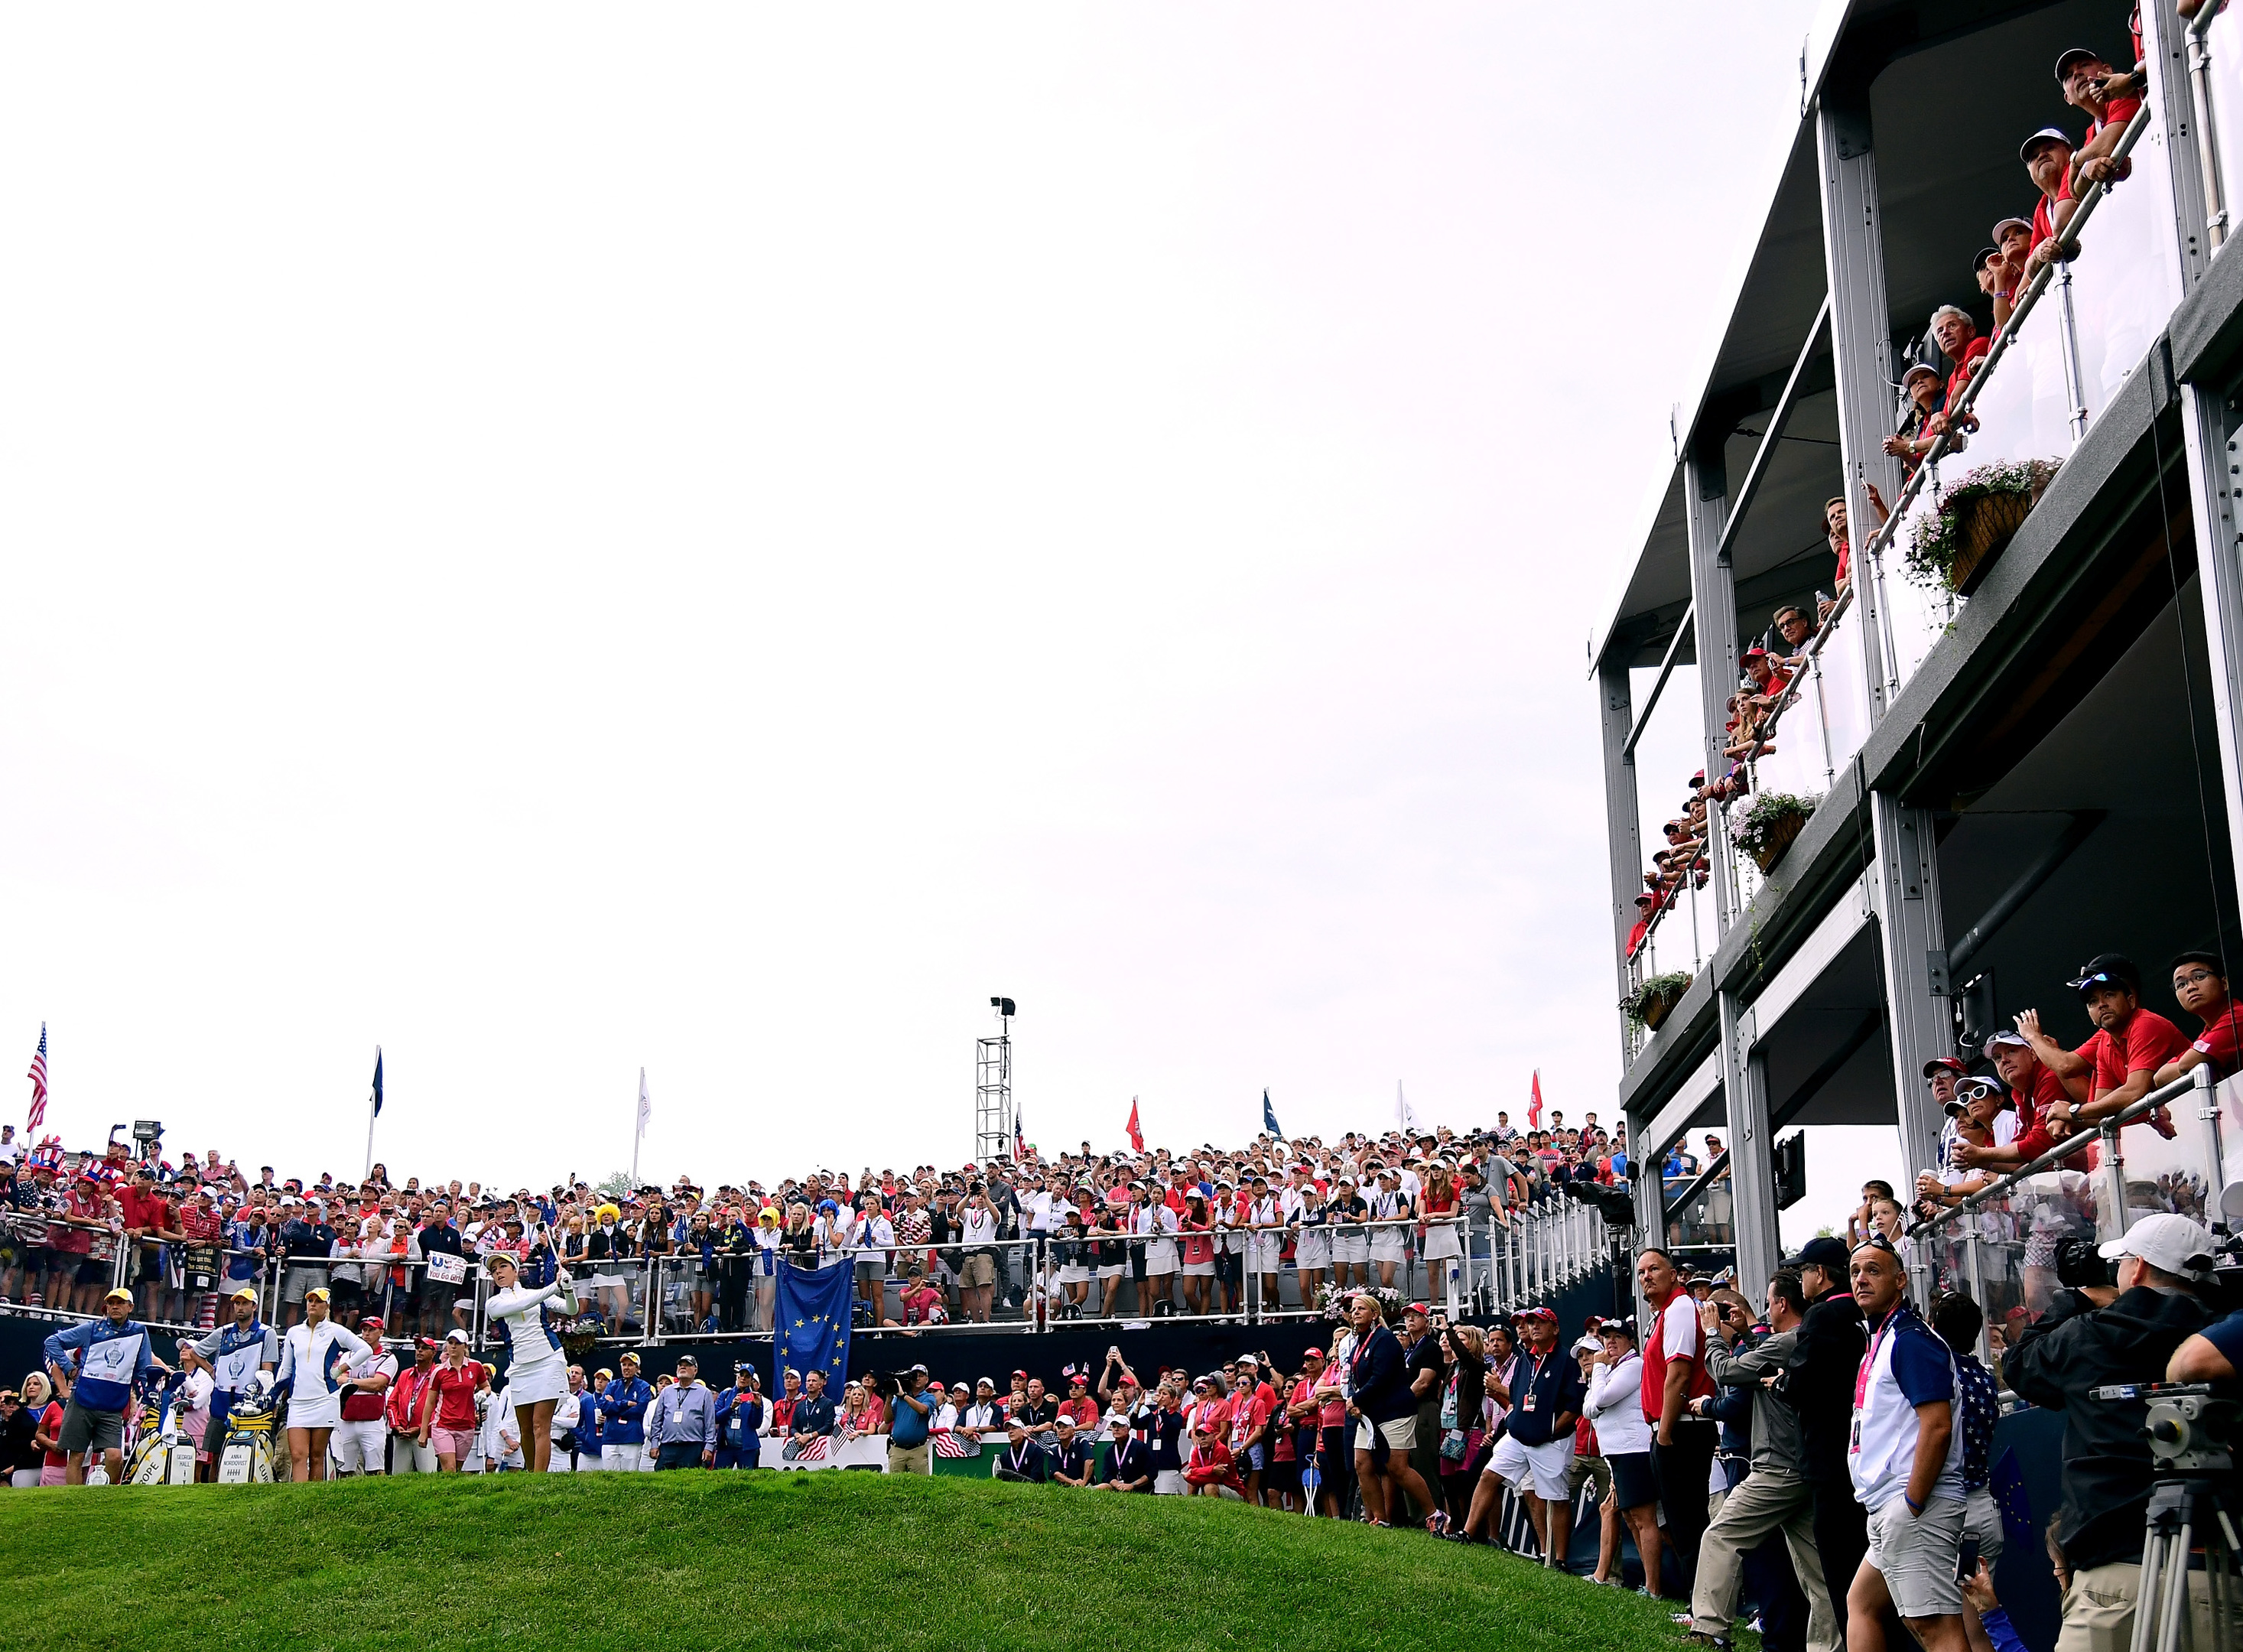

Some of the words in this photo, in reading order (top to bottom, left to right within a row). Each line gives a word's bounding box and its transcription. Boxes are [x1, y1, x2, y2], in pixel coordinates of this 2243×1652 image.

[432, 1256, 464, 1272] USA
[430, 1270, 440, 1278] You
[441, 1272, 450, 1280] Go
[1863, 1356, 1872, 1375] MEDIA
